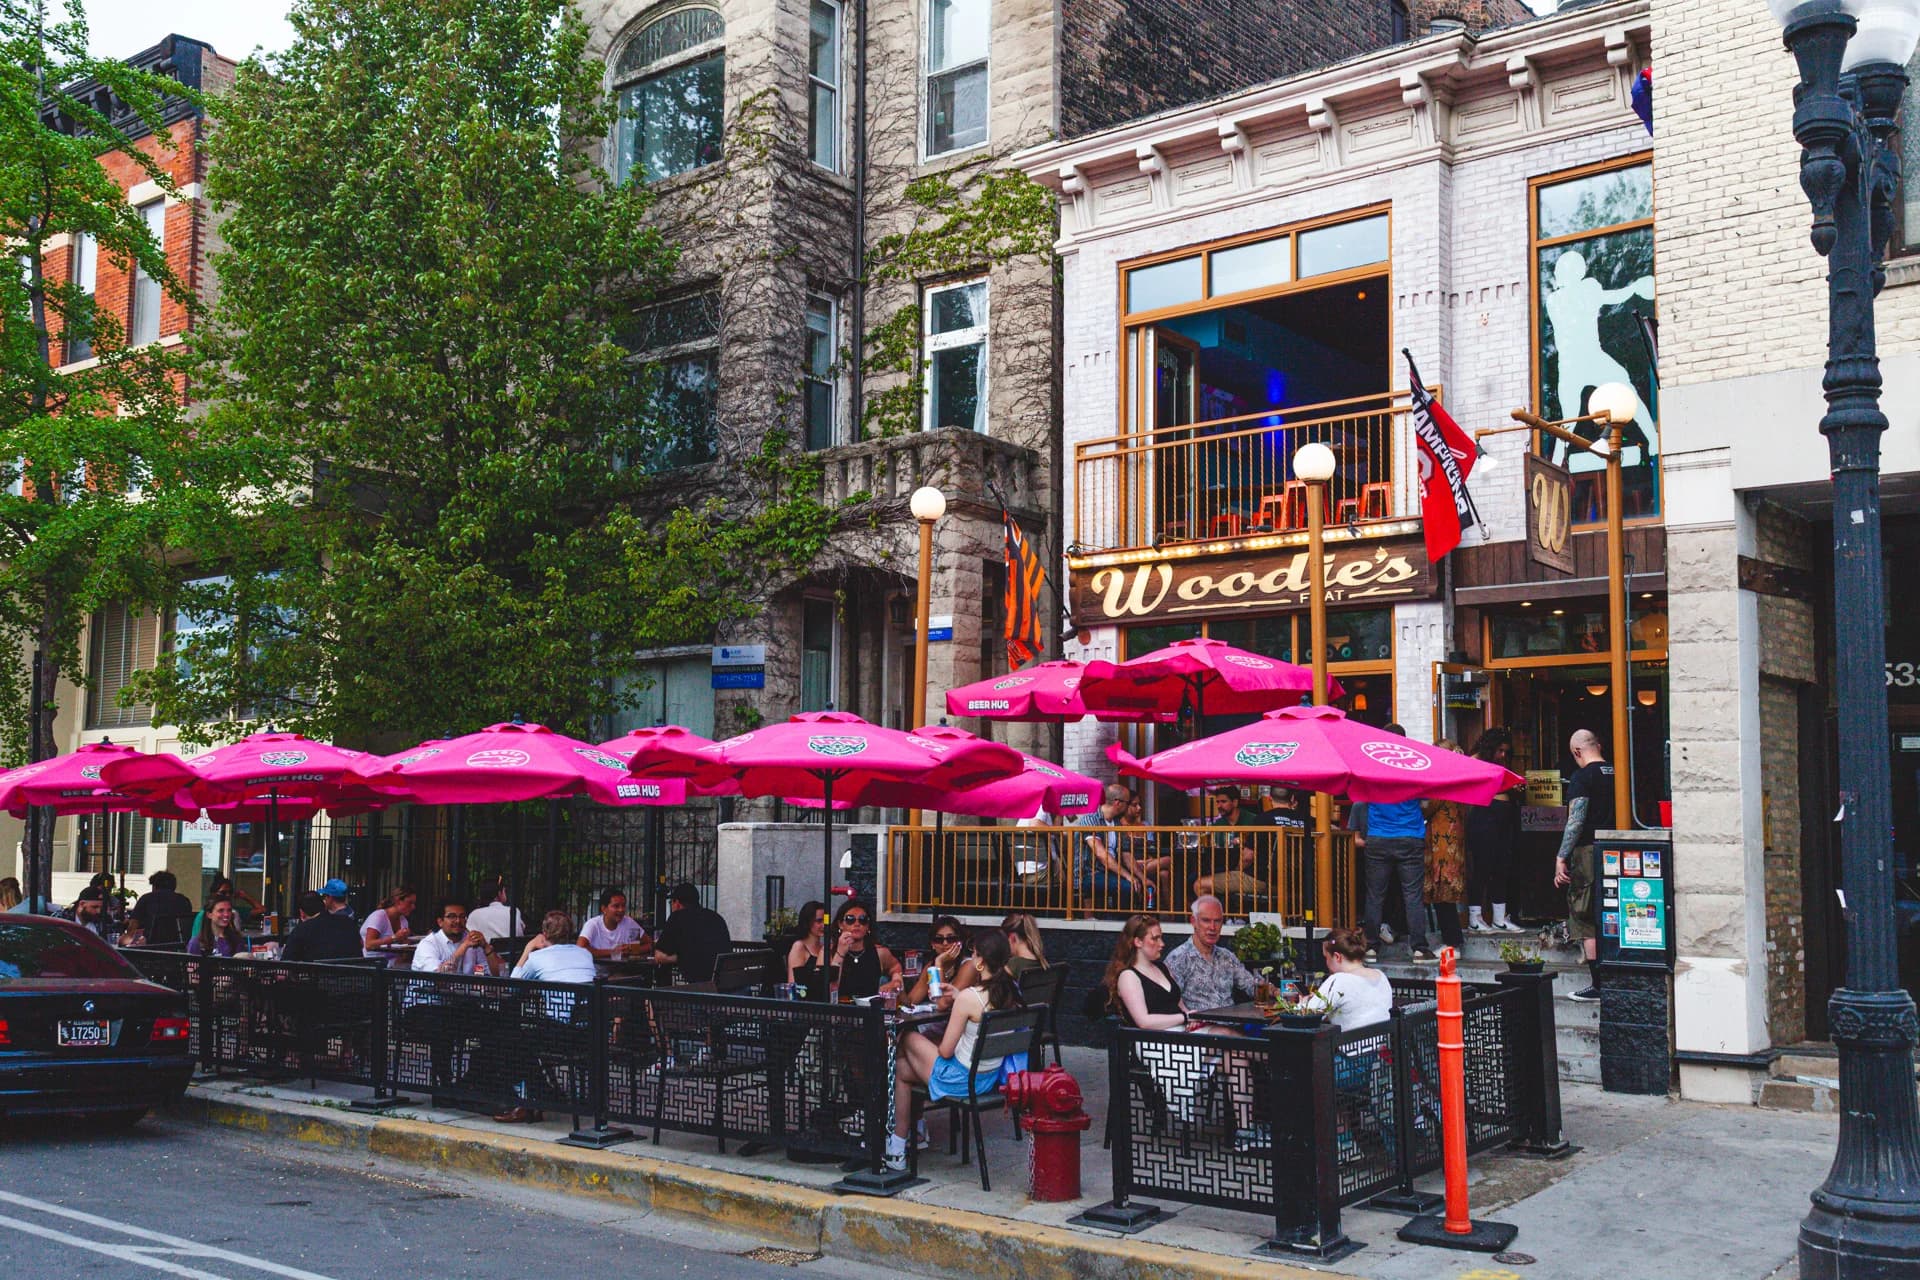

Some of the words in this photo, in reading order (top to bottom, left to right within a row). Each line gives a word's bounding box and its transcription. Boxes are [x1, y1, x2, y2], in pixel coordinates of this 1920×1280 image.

[1532, 472, 1568, 553] W
[1090, 545, 1418, 618] Woodie's
[1299, 589, 1345, 604] FAT
[967, 700, 990, 710] BEER
[990, 700, 1010, 710] HUG
[181, 744, 199, 755] 1541
[291, 774, 324, 782] HUG
[616, 783, 640, 798] BEER
[641, 784, 661, 798] HUG
[1060, 793, 1076, 807] BEER
[1076, 793, 1088, 807] HUG
[185, 822, 198, 831] FOR
[200, 822, 220, 831] LEASE
[71, 1026, 100, 1040] 17250
